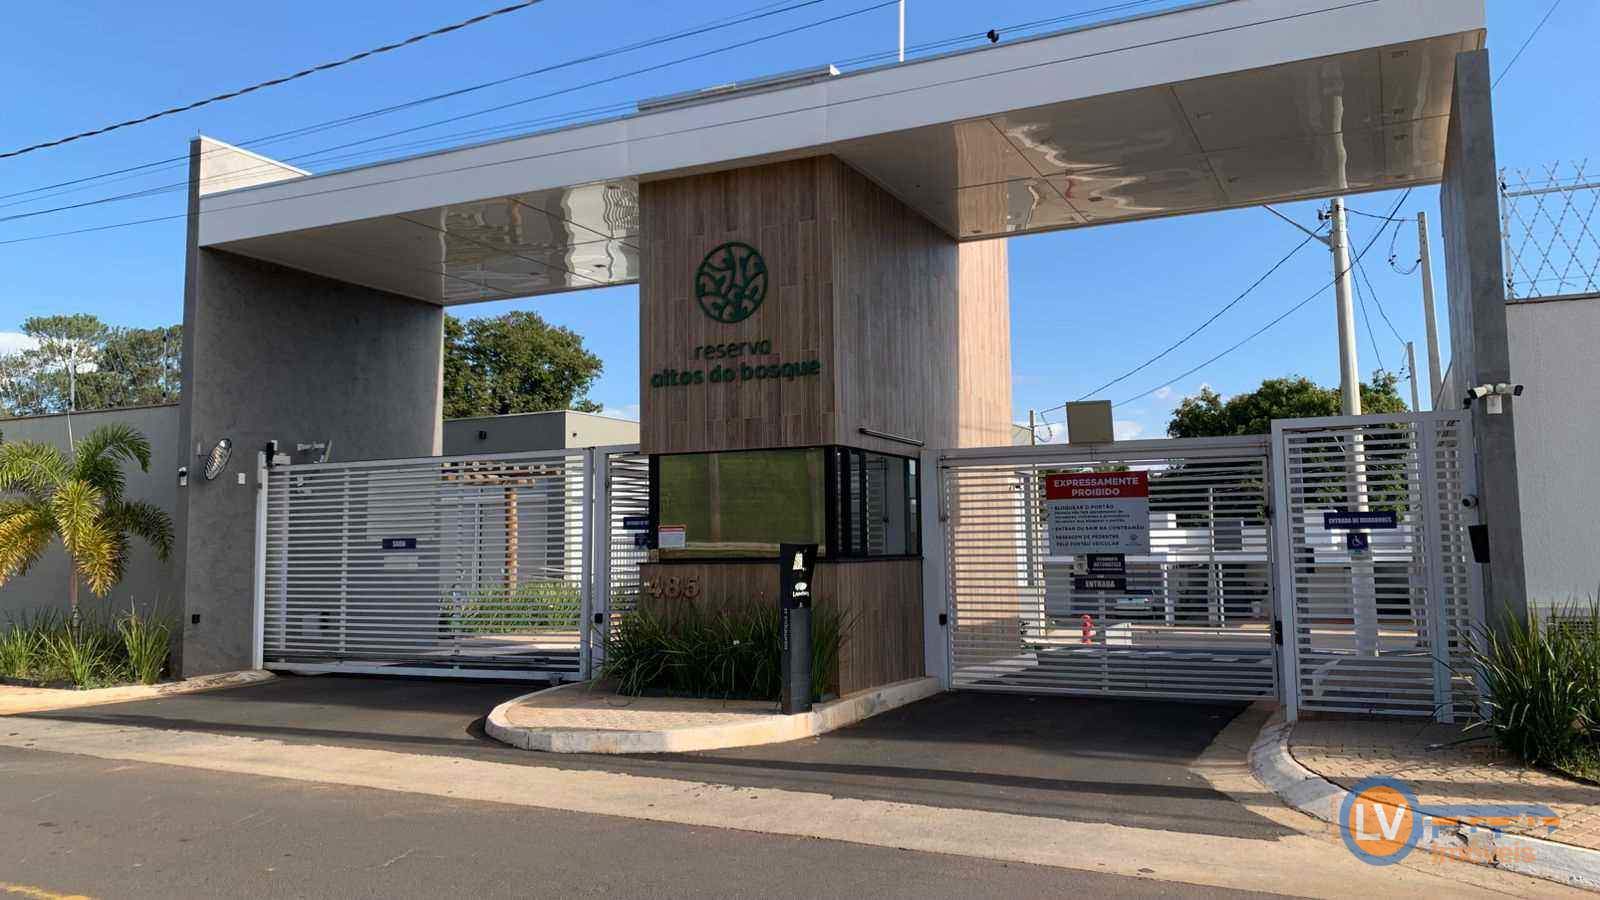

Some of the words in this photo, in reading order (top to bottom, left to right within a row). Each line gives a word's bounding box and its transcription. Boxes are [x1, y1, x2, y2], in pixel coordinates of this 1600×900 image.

[694, 339, 771, 360] reserva
[651, 367, 704, 388] altos
[709, 364, 737, 384] do
[740, 359, 821, 381] bosque
[1054, 477, 1139, 488] EXPRESSAMENTE
[1072, 488, 1120, 497] PROIBIDO
[646, 576, 701, 599] 485
[1085, 580, 1116, 588] ENTRADA
